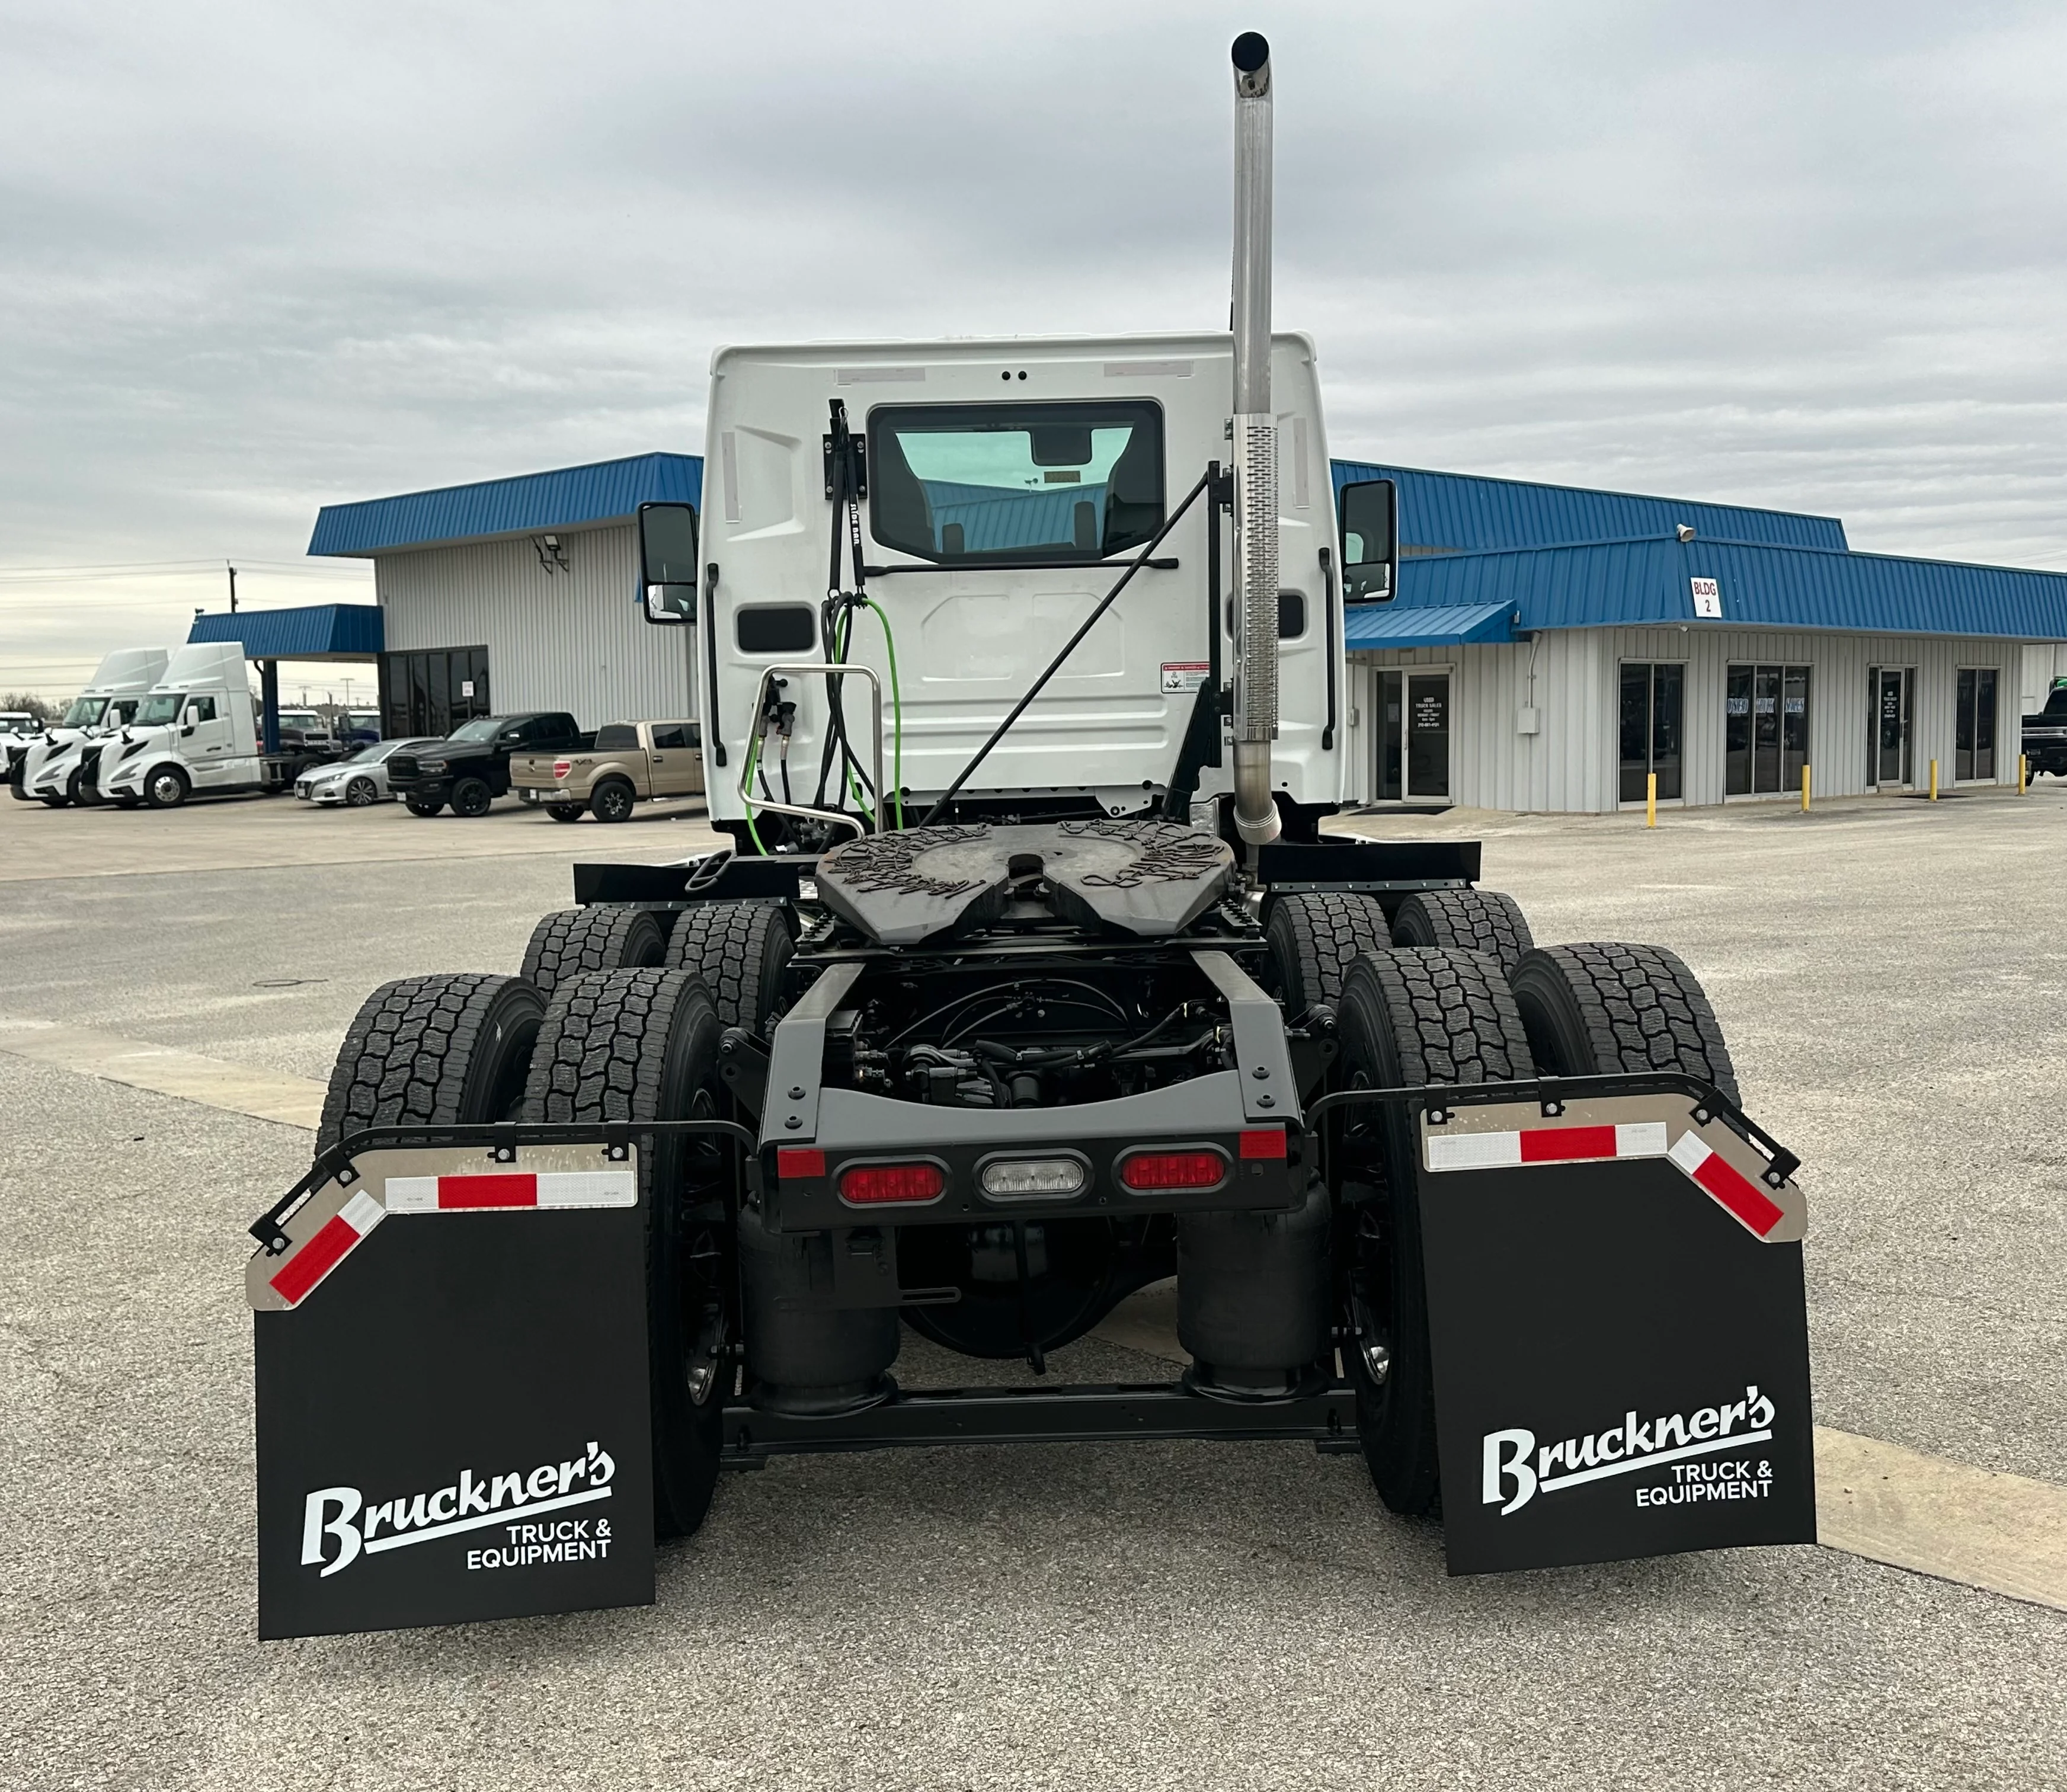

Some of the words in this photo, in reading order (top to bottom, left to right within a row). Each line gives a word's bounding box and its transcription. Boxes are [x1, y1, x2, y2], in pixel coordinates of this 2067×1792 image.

[1694, 582, 1716, 596] BLDG
[1705, 599, 1711, 612] 2
[1727, 697, 1749, 714] USED
[1483, 1385, 1775, 1516] Bruckner's
[1671, 1461, 1751, 1483] TRUCK
[1756, 1460, 1773, 1478] &
[1636, 1480, 1772, 1507] EQUIPMENT
[301, 1442, 615, 1577] Bruckner's
[507, 1519, 590, 1545] TRUCK
[595, 1518, 612, 1538] &
[467, 1539, 612, 1570] EQUIPMENT
